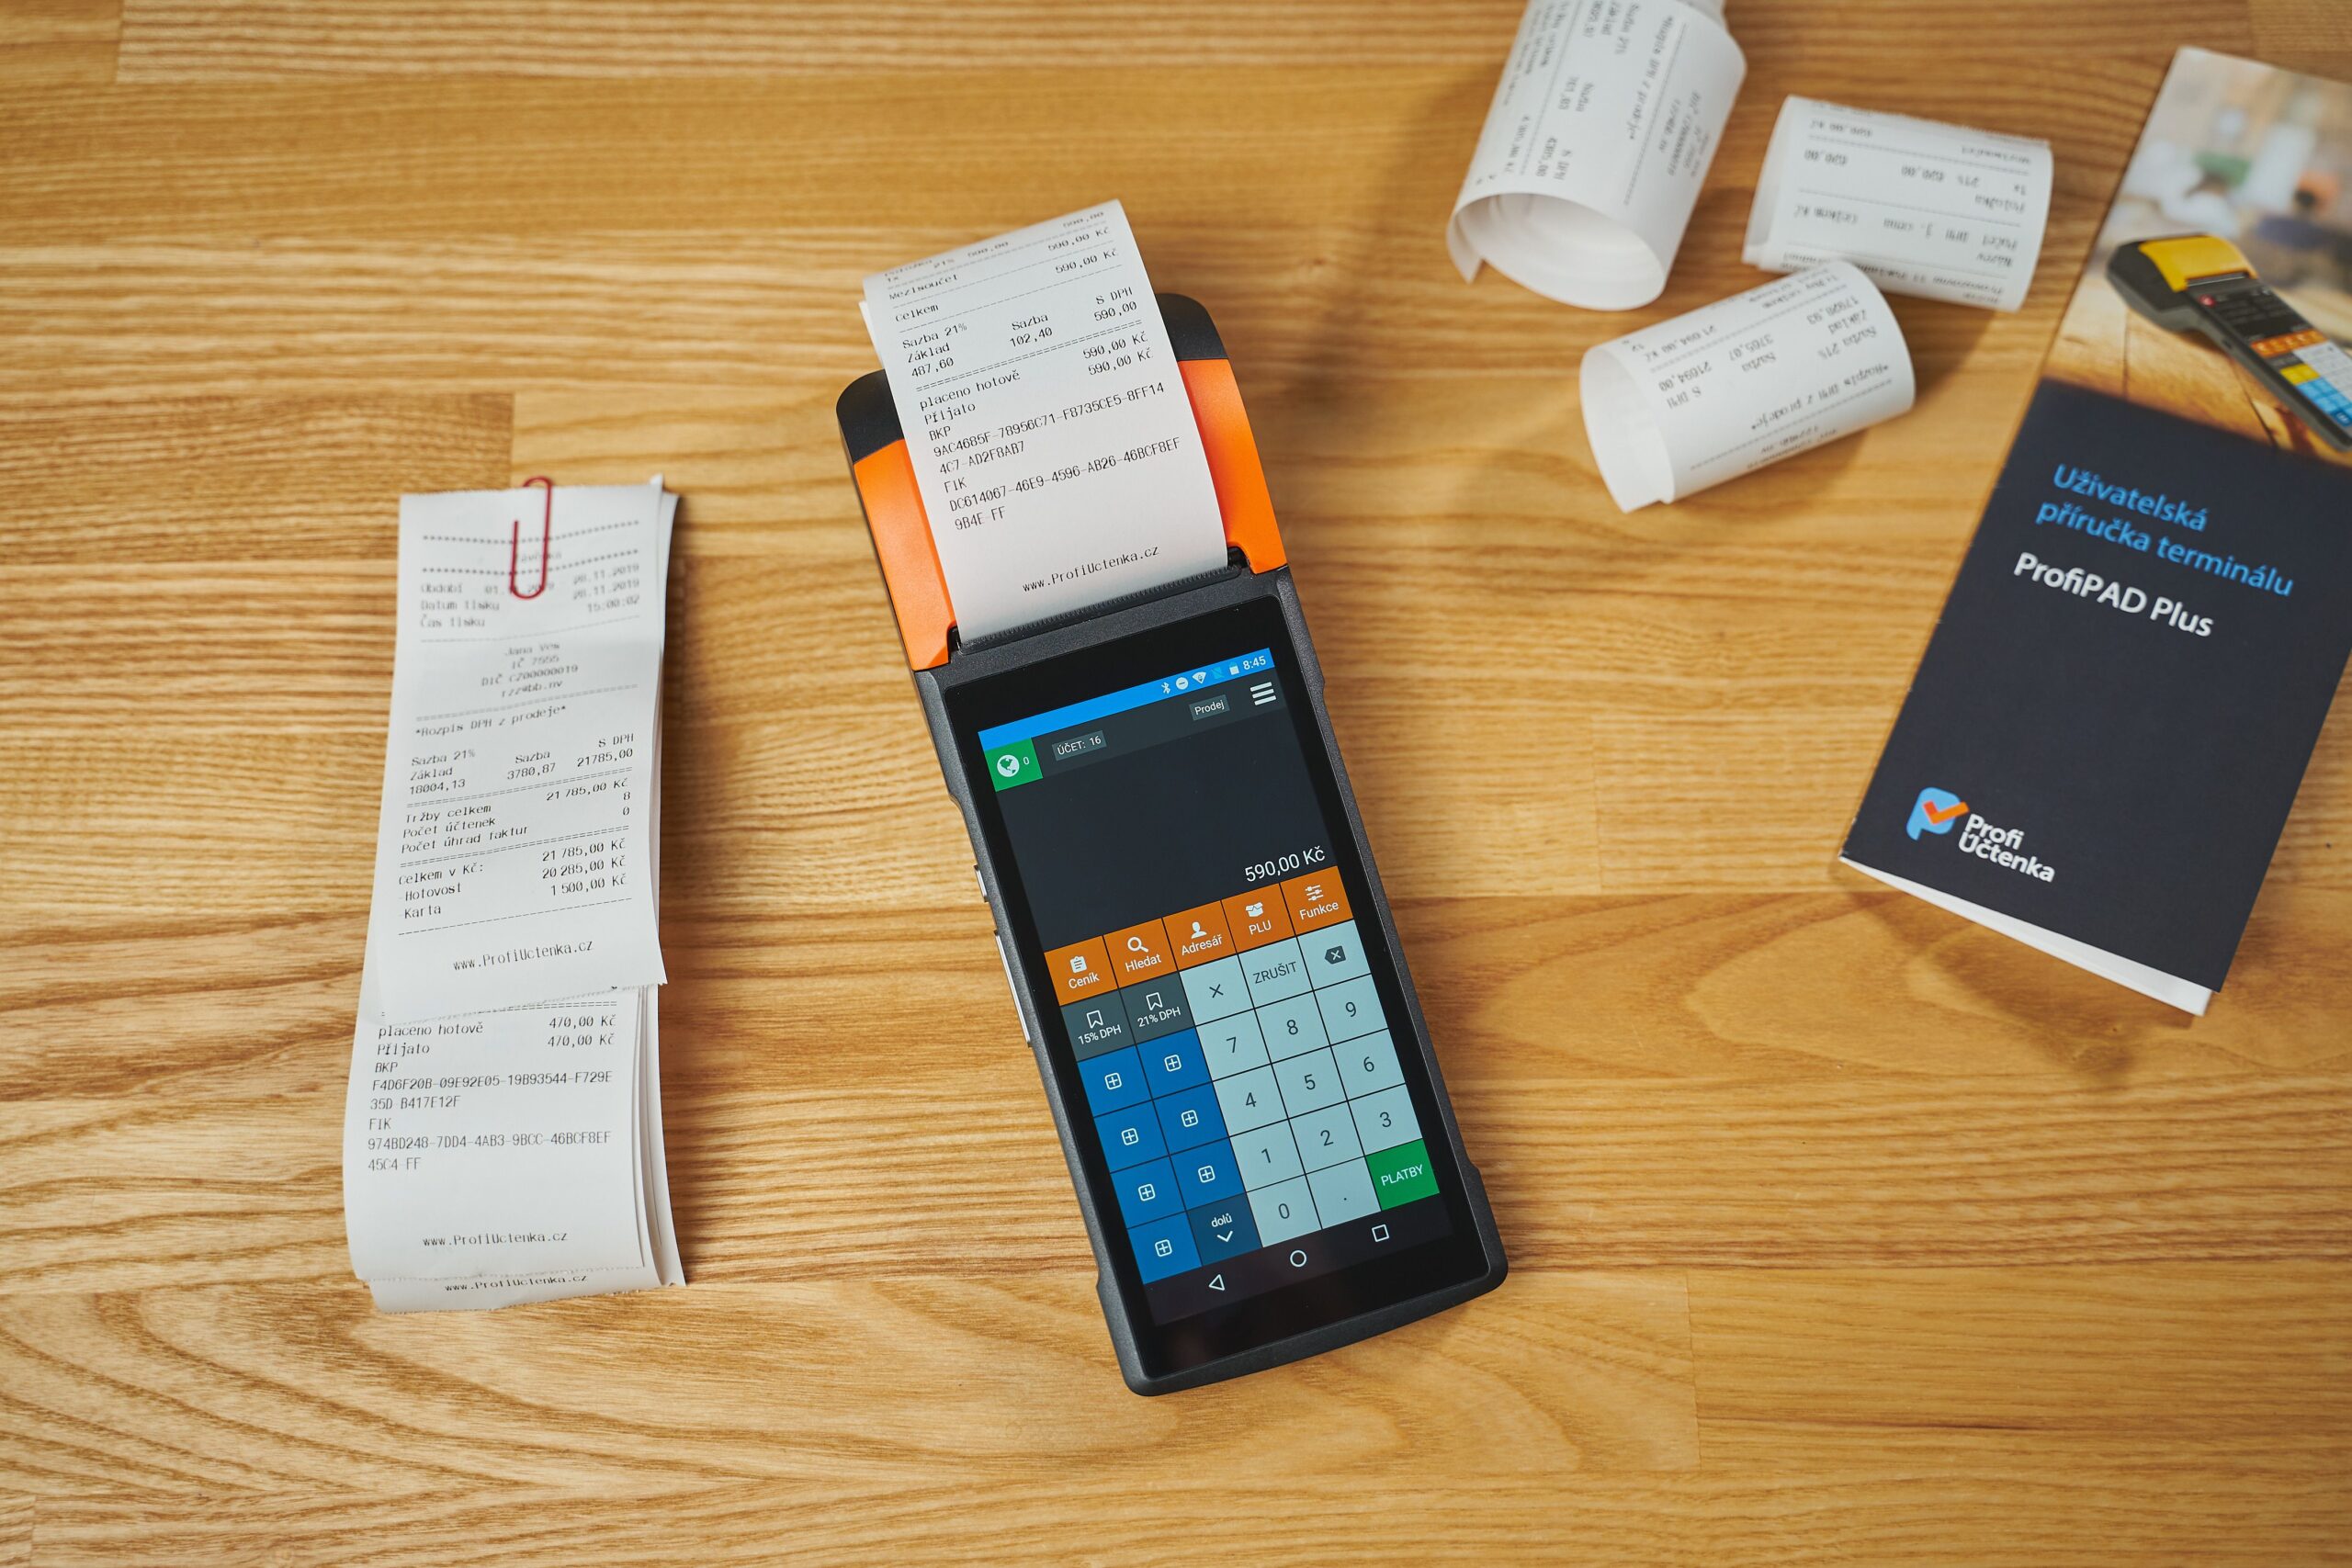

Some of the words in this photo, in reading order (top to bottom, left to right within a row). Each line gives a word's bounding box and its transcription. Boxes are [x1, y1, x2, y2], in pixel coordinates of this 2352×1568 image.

[895, 303, 939, 321] Celkem
[1056, 254, 1097, 274] 590,00
[1096, 295, 1103, 304] S
[1110, 288, 1132, 301] DPH
[902, 331, 938, 348] Sazba
[945, 322, 967, 337] 21%
[908, 343, 950, 364] Základ
[1012, 312, 1047, 331] Sazba
[911, 357, 954, 378] 487,60
[1010, 327, 1053, 346] 102,40
[1094, 301, 1137, 321] 590,00
[920, 386, 970, 410] placeno
[976, 369, 1020, 391] hotově
[1083, 338, 1125, 359] 590,00
[1132, 331, 1147, 344] Kč
[924, 402, 976, 424] Přijato
[1088, 355, 1131, 376] 590,00
[1137, 346, 1153, 362] Kč
[929, 426, 951, 441] BKP
[944, 478, 967, 493] FIK
[2053, 464, 2208, 532] Uživatelská
[2035, 502, 2152, 552] příručka
[2157, 536, 2293, 596] terminálu
[1023, 546, 1159, 592] www.ProfiUctenka.cz
[485, 581, 554, 594] 01..209
[2014, 552, 2147, 614] ProfiPAD
[2150, 596, 2214, 637] Plus
[421, 600, 458, 611] Datum
[421, 615, 442, 627] Čas
[1243, 655, 1266, 670] 8:45
[1194, 699, 1225, 716] Prodej
[471, 718, 492, 729] DPH
[598, 739, 605, 748] S
[613, 734, 634, 745] DPH
[1057, 737, 1086, 755] ÚČET:
[1089, 736, 1101, 746] 16
[410, 767, 453, 781] Základ
[515, 750, 550, 764] Sazba
[412, 754, 447, 766] Sazba
[454, 749, 476, 761] 21%
[1023, 756, 1029, 765] 0
[410, 780, 465, 795] 18004,13
[507, 763, 556, 780] 3780,87
[577, 749, 633, 767] 21785,00
[406, 812, 440, 823] Tržby
[447, 806, 492, 818] celkem
[614, 778, 628, 788] Kč
[403, 827, 436, 839] Počet
[446, 818, 495, 832] účtenek
[624, 792, 630, 800] 8
[401, 840, 436, 853] Počet
[444, 831, 481, 848] úhrad
[489, 826, 528, 840] faktur
[622, 807, 629, 816] 0
[1965, 813, 2024, 850] Profi
[399, 871, 442, 885] Celkem
[463, 863, 483, 875] Kč:
[611, 838, 626, 851] Kč
[611, 857, 626, 868] Kč
[1245, 854, 1300, 882] 590,00
[1303, 846, 1325, 865] Kč
[1959, 831, 2055, 883] Účtenka
[612, 874, 627, 886] Kč
[1299, 899, 1339, 920] Funkce
[1249, 919, 1272, 935] PLU
[1181, 933, 1222, 955] Adresář
[453, 941, 594, 971] www.ProfiUctenka.cz
[1125, 952, 1161, 972] Hledat
[1069, 971, 1099, 989] Ceník
[1253, 960, 1297, 985] ZRUŠIT
[1137, 1012, 1157, 1028] 21%
[1157, 1005, 1181, 1021] DPH
[1346, 1001, 1356, 1017] 9
[379, 1023, 432, 1039] placeno
[438, 1021, 483, 1035] hotově
[549, 1017, 594, 1028] 470,00
[600, 1014, 616, 1027] Kč
[1079, 1030, 1098, 1045] 15%
[1099, 1023, 1121, 1039] DPH
[1287, 1020, 1298, 1035] 8
[378, 1043, 430, 1057] Přijato
[548, 1034, 593, 1047] 470,00
[599, 1033, 616, 1045] Kč
[1227, 1037, 1238, 1053] 7
[375, 1062, 398, 1073] BKP
[1363, 1056, 1374, 1072] 6
[1305, 1075, 1316, 1089] 5
[1245, 1092, 1257, 1108] 4
[369, 1119, 391, 1130] FIK
[1380, 1111, 1391, 1127] 3
[1321, 1130, 1333, 1146] 2
[1261, 1149, 1271, 1163] 1
[1381, 1164, 1423, 1186] PLATBY
[1211, 1213, 1231, 1227] dolů
[1278, 1203, 1289, 1219] 0
